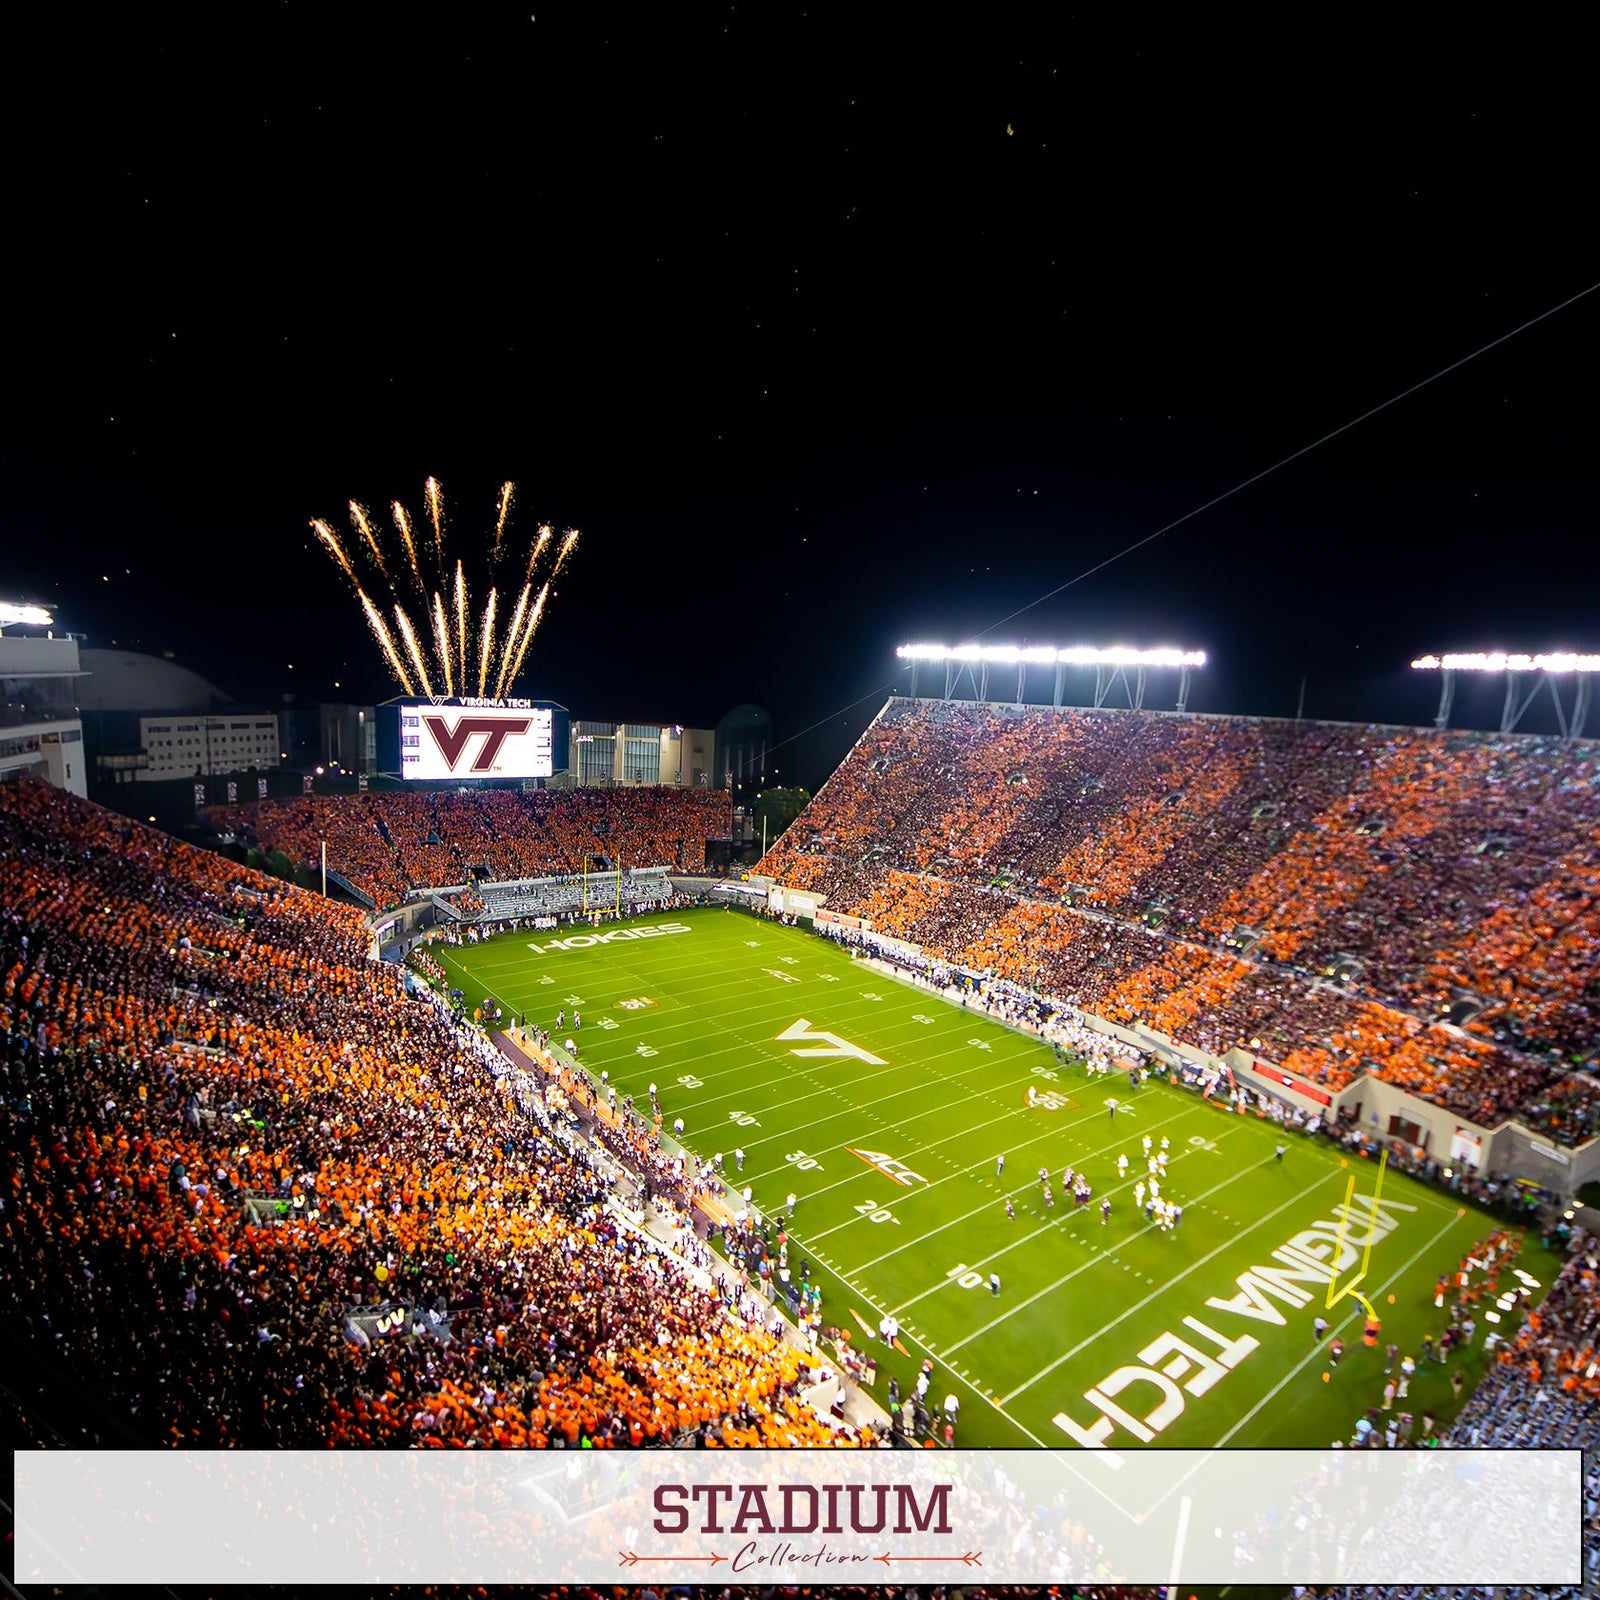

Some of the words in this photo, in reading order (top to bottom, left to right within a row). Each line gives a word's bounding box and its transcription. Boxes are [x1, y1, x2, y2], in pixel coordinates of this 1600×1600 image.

[459, 697, 505, 708] VIRGINIA
[506, 698, 531, 709] TECH
[421, 715, 534, 772] VT
[527, 922, 692, 954] HOKIES
[774, 1018, 890, 1065] VT
[677, 1074, 704, 1089] 50
[729, 1110, 757, 1127] 40
[786, 1150, 818, 1171] 30
[854, 1148, 929, 1187] ACC
[854, 1200, 892, 1223] 20
[1205, 1193, 1418, 1326] VIRGINIA
[946, 1263, 983, 1288] 10
[1051, 1314, 1261, 1471] TECH
